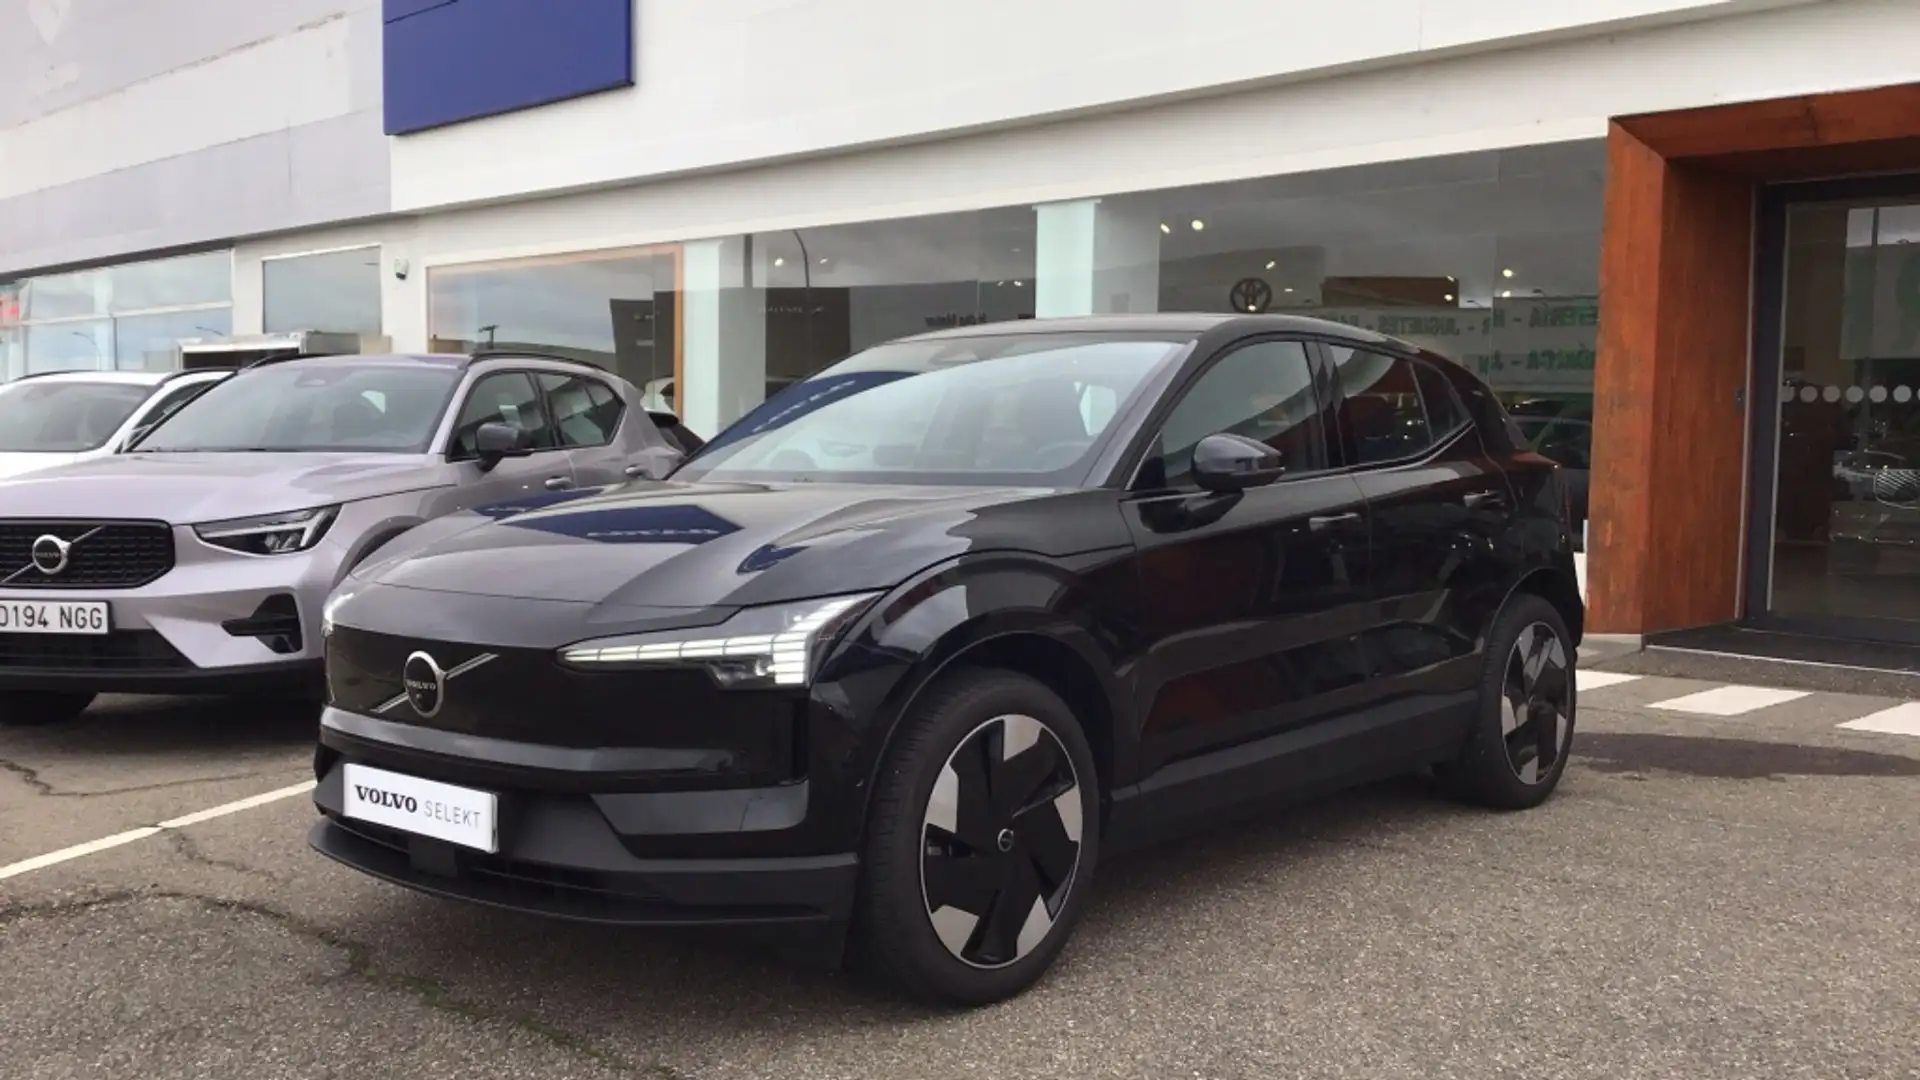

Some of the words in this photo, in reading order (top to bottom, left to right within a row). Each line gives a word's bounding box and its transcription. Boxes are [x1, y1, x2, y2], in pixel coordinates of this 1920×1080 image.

[59, 606, 103, 629] NGG
[354, 784, 418, 813] VOLVO
[423, 800, 481, 829] SELEKT
